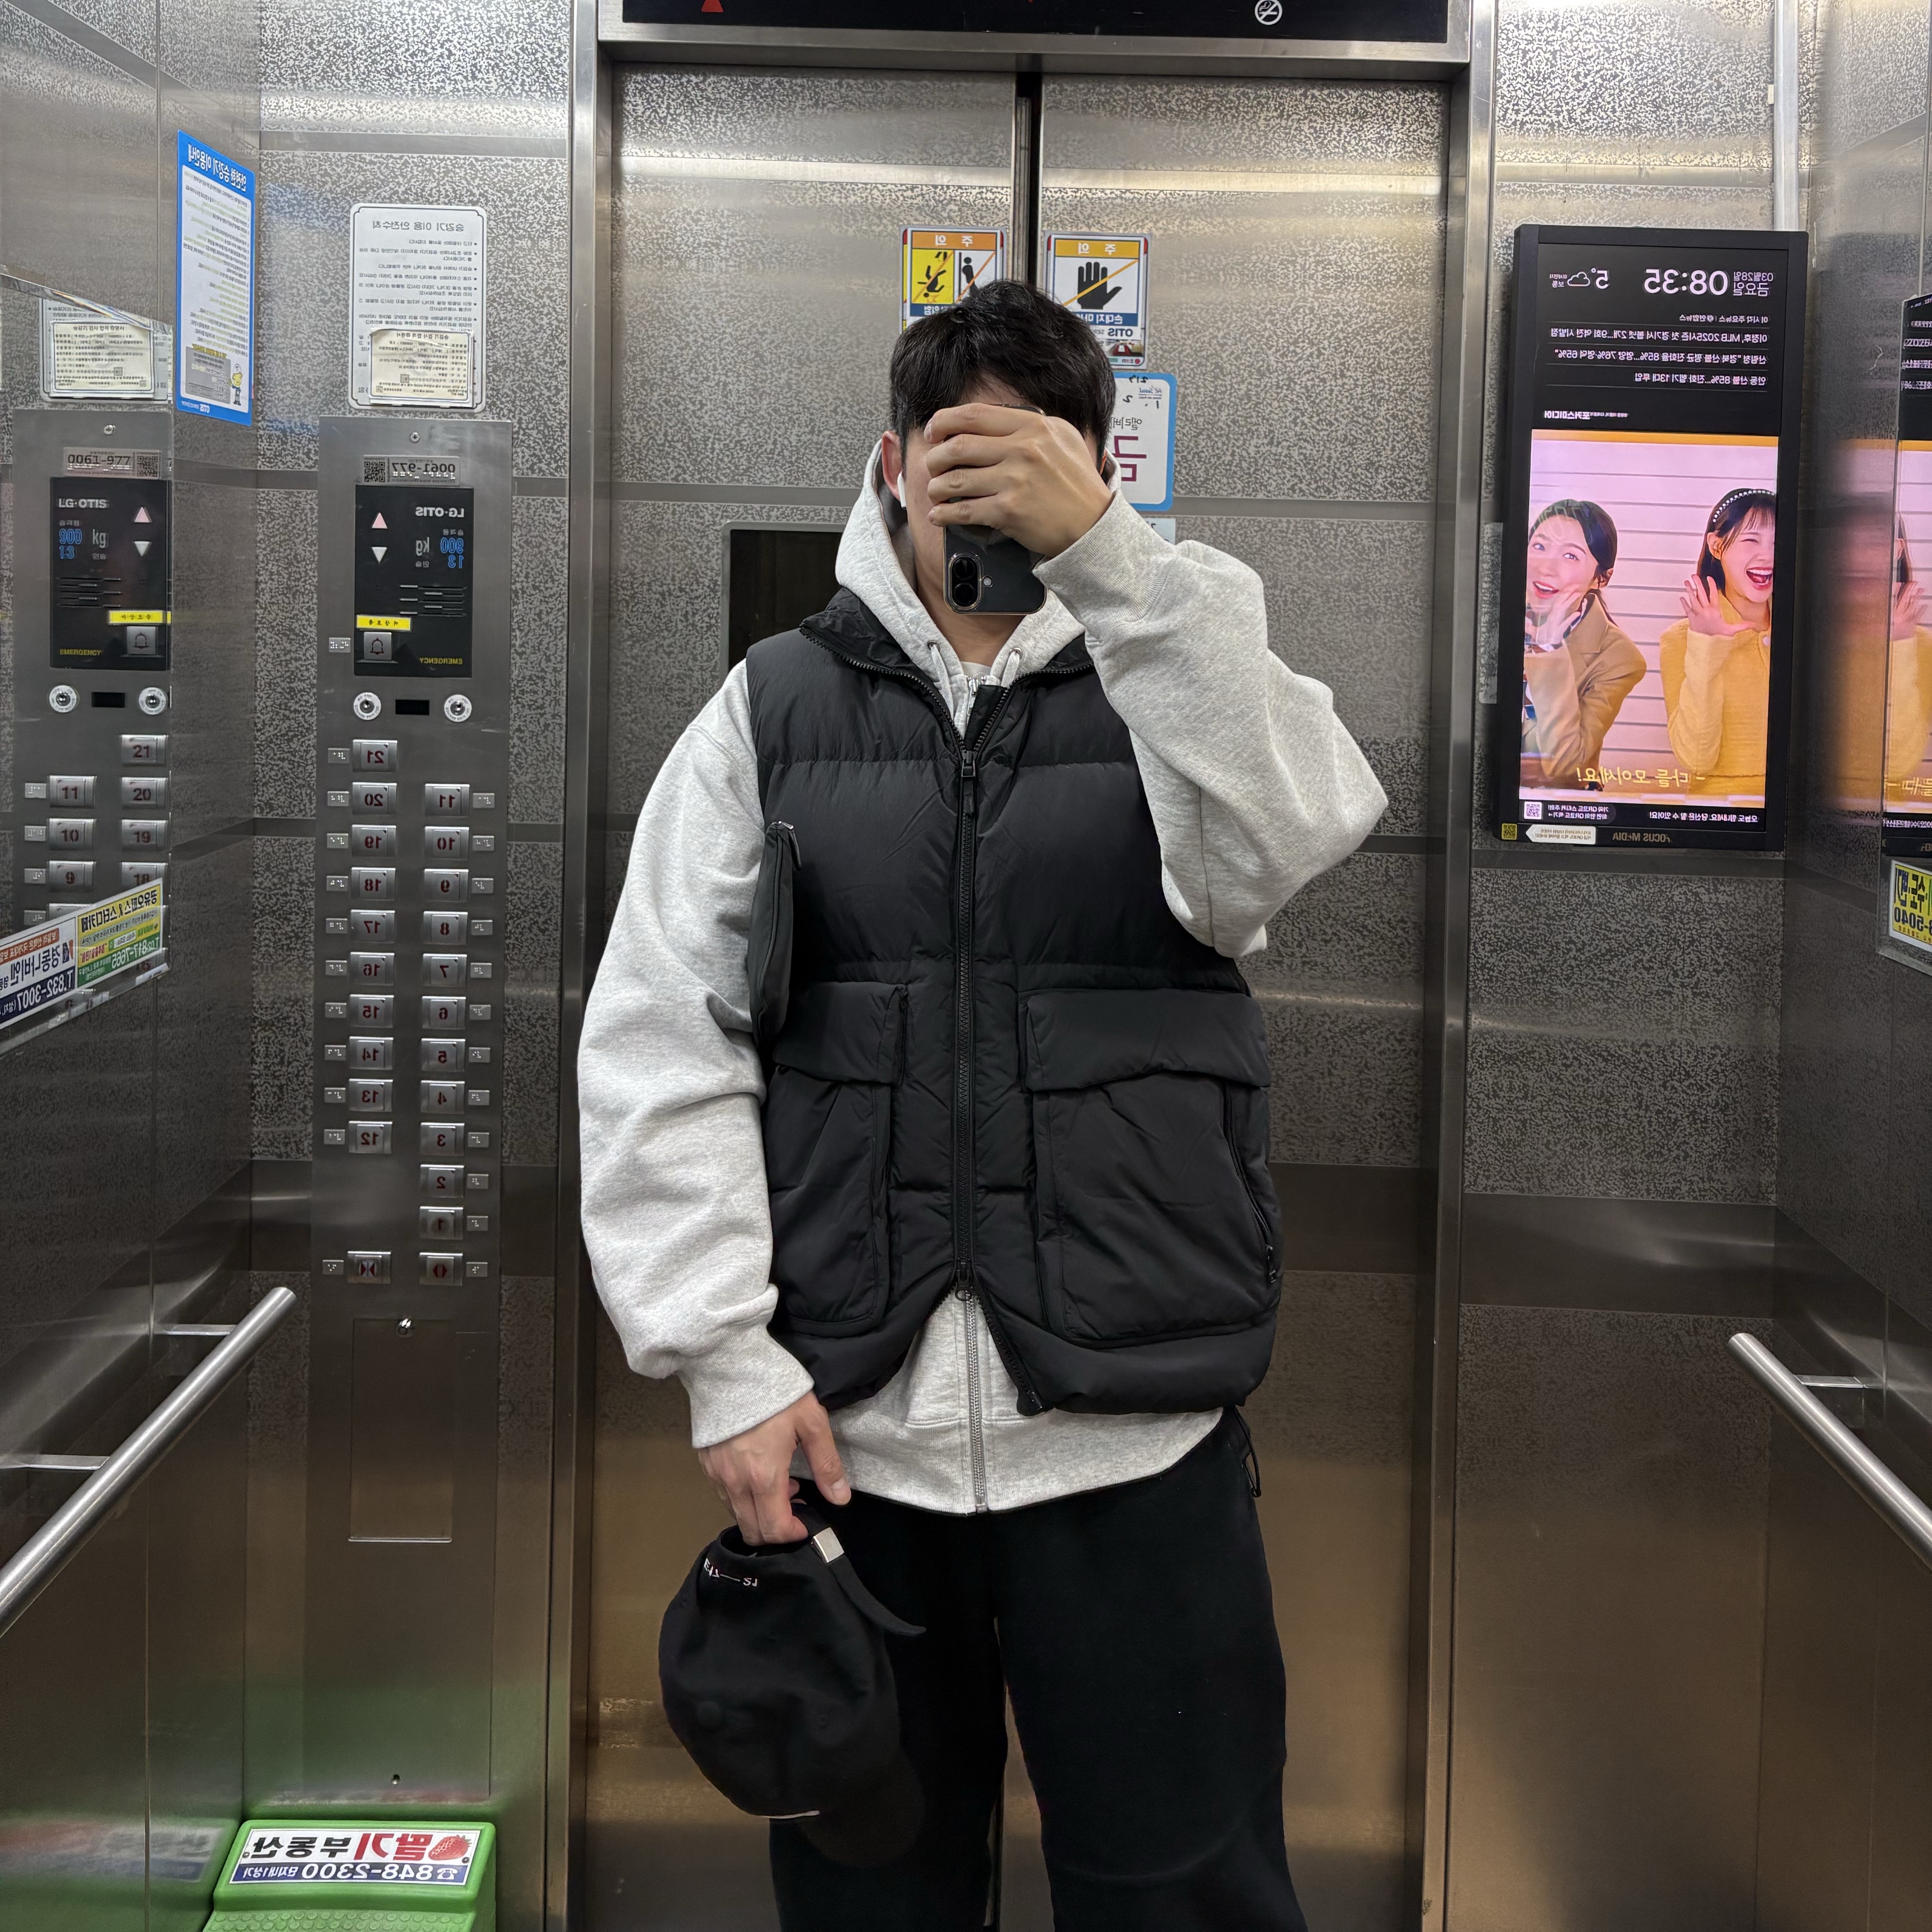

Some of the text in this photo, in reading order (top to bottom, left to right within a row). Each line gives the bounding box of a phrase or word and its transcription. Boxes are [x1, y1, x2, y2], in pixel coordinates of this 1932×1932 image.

[67, 454, 131, 465] 0061-977
[59, 529, 106, 548] 900 kg
[60, 546, 75, 559] 13
[133, 745, 150, 758] 21
[61, 786, 79, 800] 11
[133, 787, 152, 801] 20
[61, 828, 79, 842] 10
[134, 830, 151, 844] 19
[65, 871, 75, 885] 9
